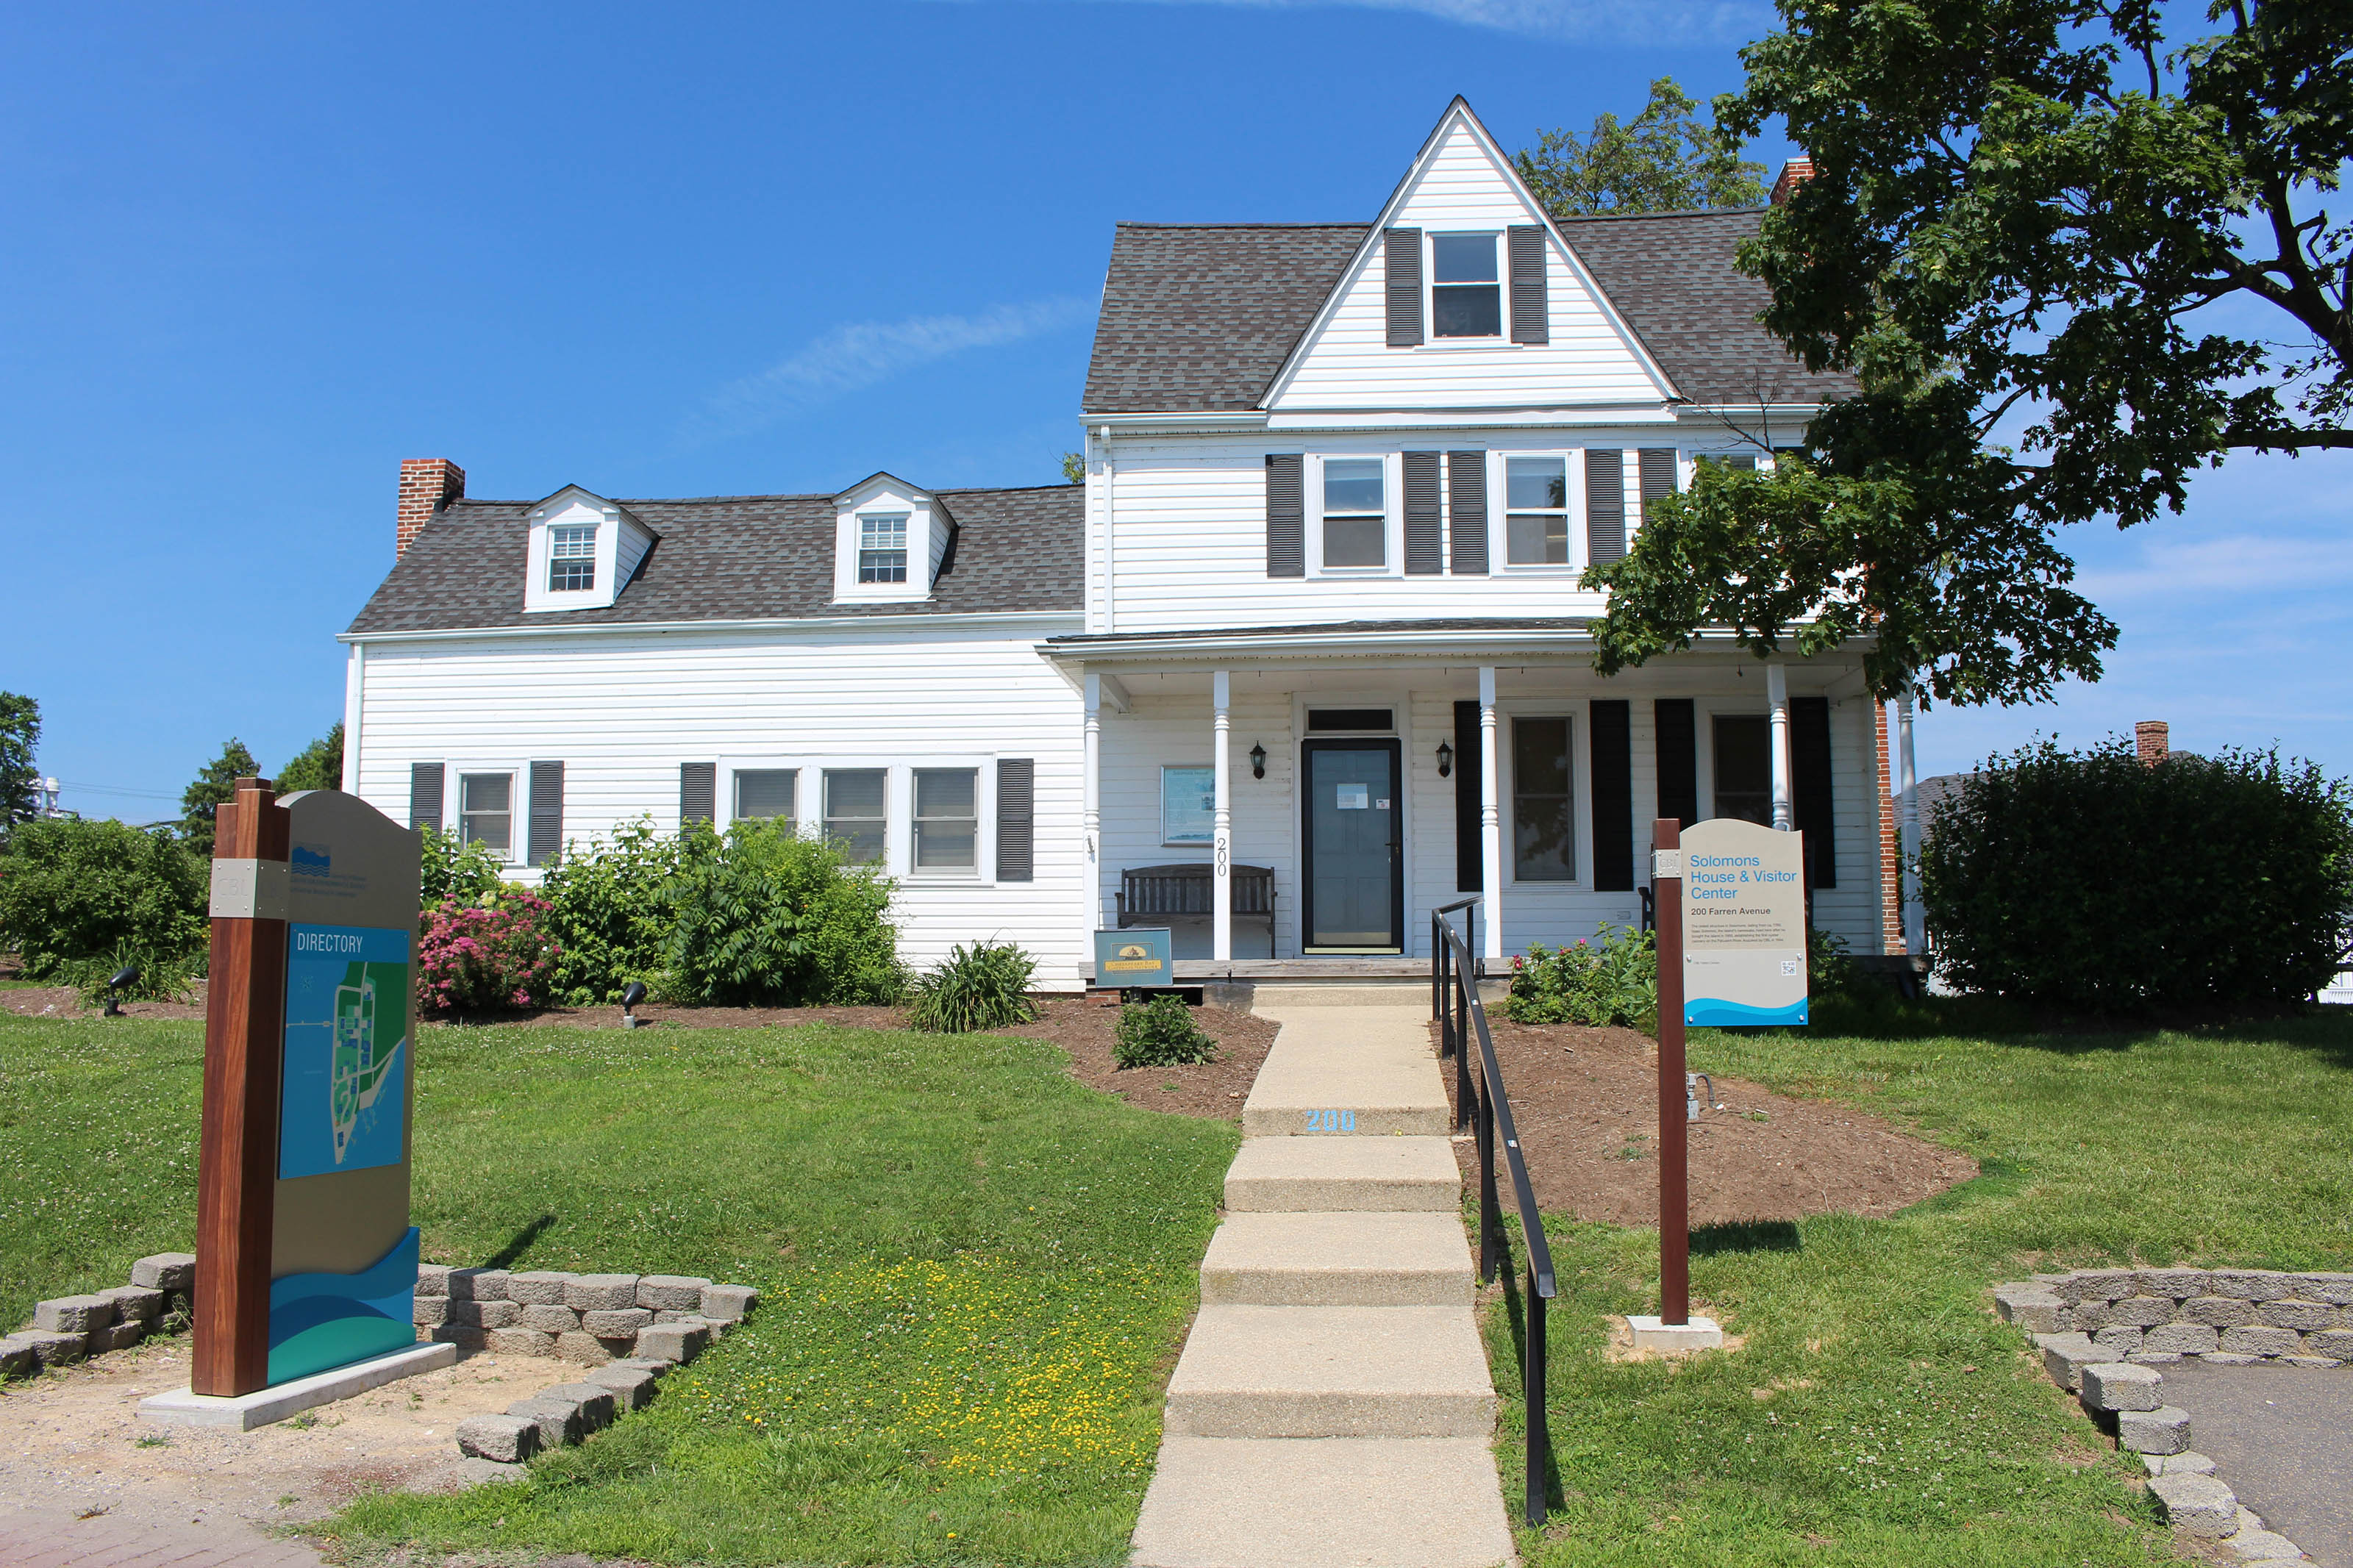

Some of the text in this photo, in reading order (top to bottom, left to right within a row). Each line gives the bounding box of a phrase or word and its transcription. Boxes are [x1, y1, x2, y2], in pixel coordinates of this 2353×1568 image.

[1217, 837, 1227, 877] 200
[1690, 854, 1760, 867] Solomons
[1691, 870, 1797, 883] House & Visitor
[1691, 887, 1738, 899] Center
[1739, 907, 1771, 915] Avenue
[297, 932, 363, 953] DIRECTORY
[1306, 1109, 1355, 1131] 200
